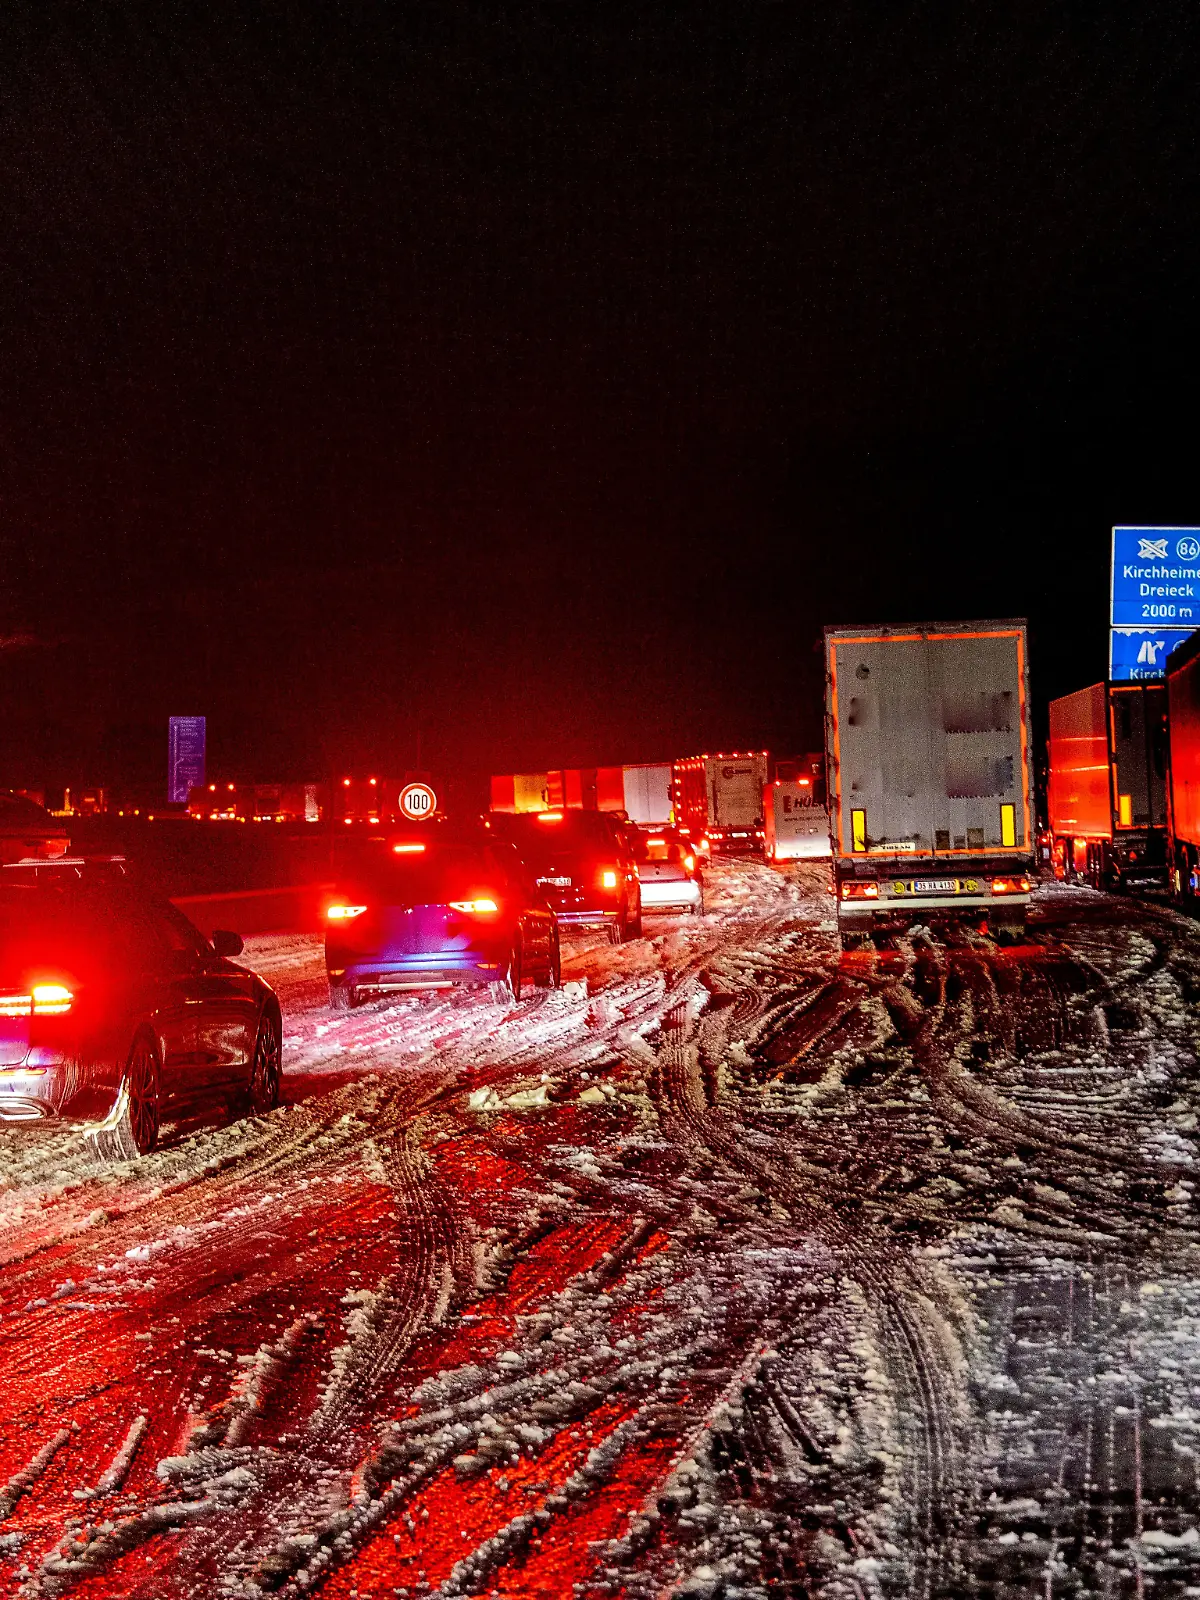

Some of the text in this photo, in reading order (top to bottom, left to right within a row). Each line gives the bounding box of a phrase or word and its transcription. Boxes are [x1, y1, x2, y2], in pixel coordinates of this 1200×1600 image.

[1180, 542, 1197, 556] 86
[1140, 583, 1194, 597] Dreieck
[1142, 604, 1193, 618] 2000 m
[407, 794, 428, 810] 100
